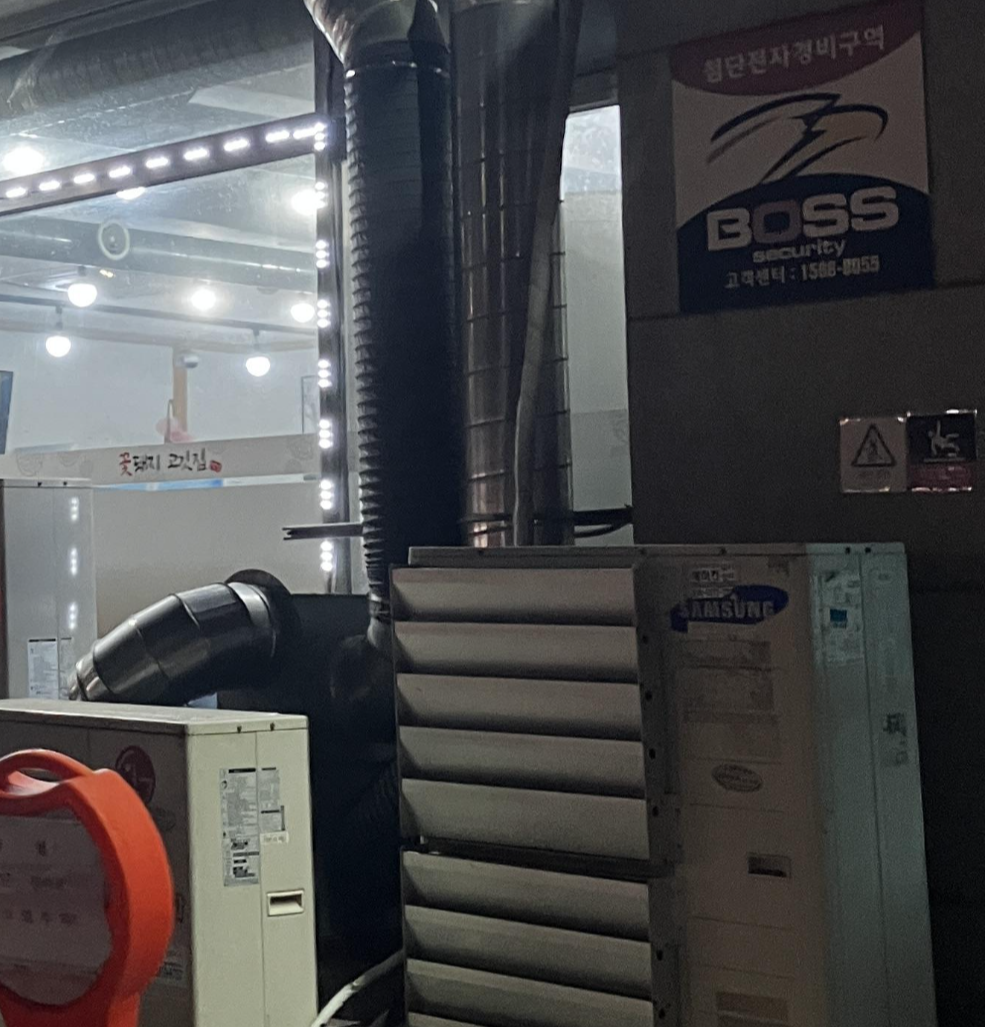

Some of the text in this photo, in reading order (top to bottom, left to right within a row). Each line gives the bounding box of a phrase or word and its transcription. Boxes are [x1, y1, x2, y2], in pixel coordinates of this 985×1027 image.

[706, 185, 899, 251] BOSS
[752, 238, 847, 263] security
[679, 599, 775, 620] SAMSUNG
